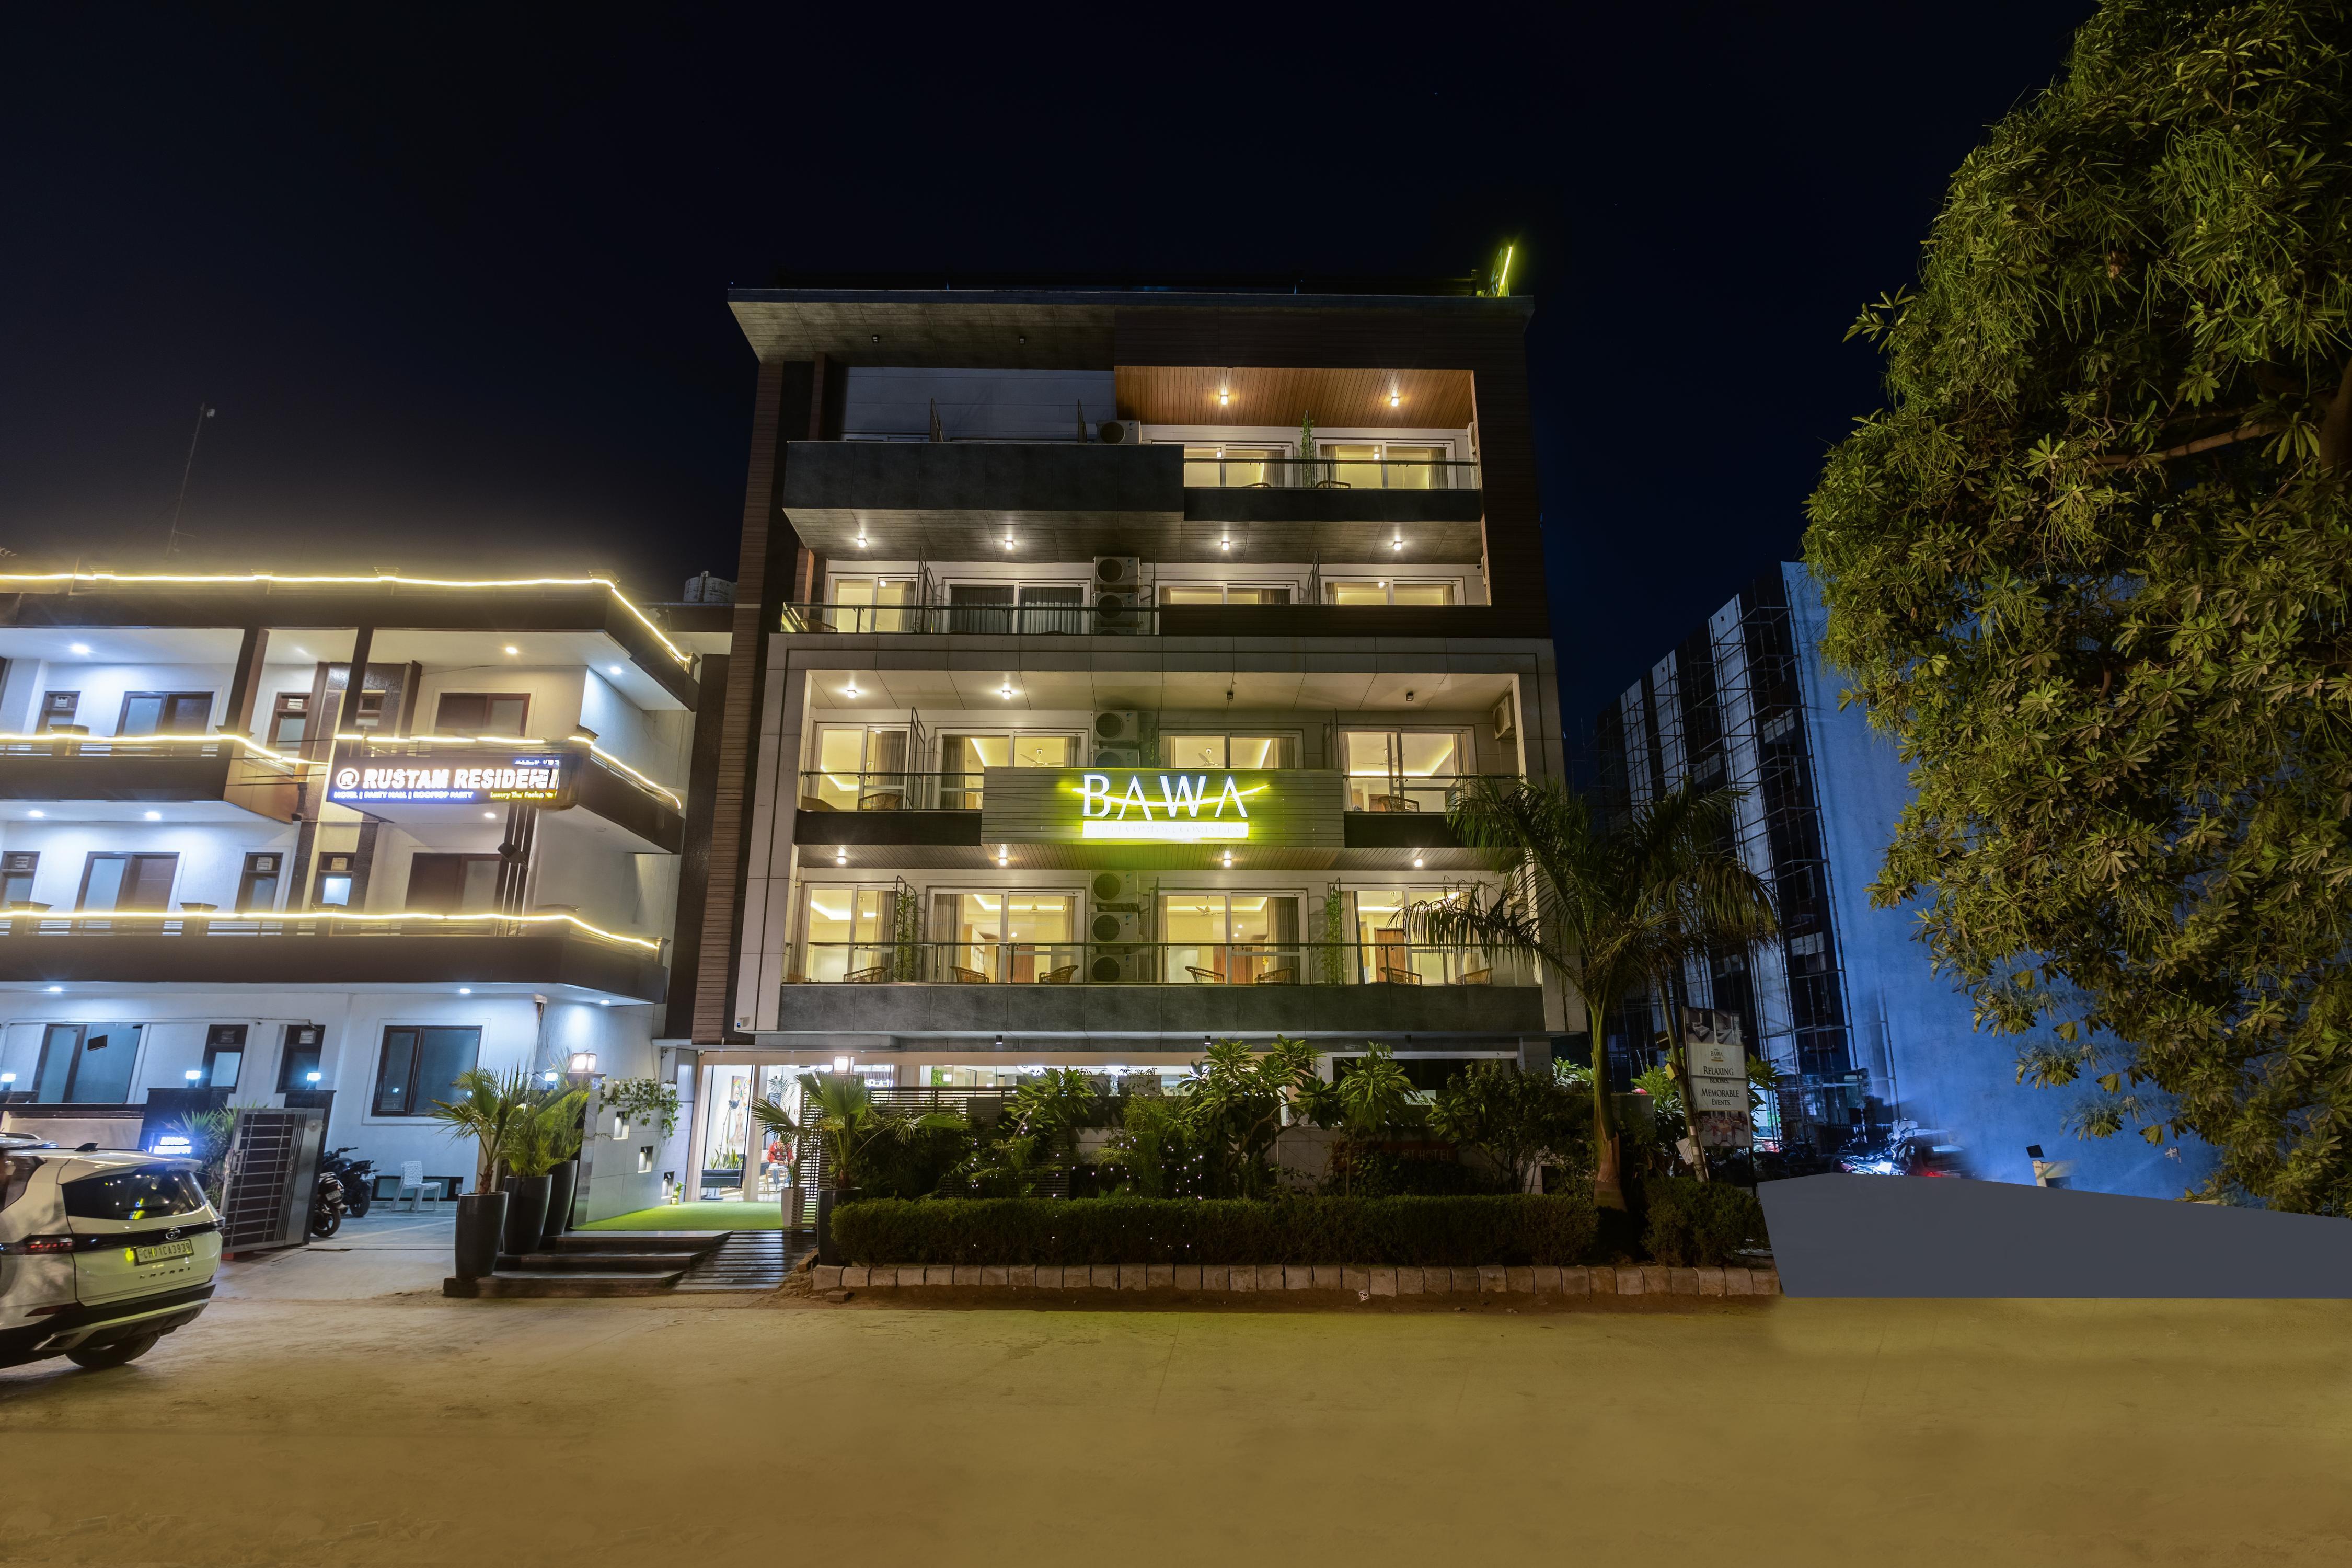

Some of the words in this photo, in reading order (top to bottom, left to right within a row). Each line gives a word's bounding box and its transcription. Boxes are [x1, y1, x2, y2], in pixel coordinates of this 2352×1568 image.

[363, 769, 450, 789] RUSTAM
[1082, 774, 1248, 820] BAWA
[1703, 1066, 1734, 1076] RELAXING
[1701, 1088, 1740, 1098] MEMORABLE
